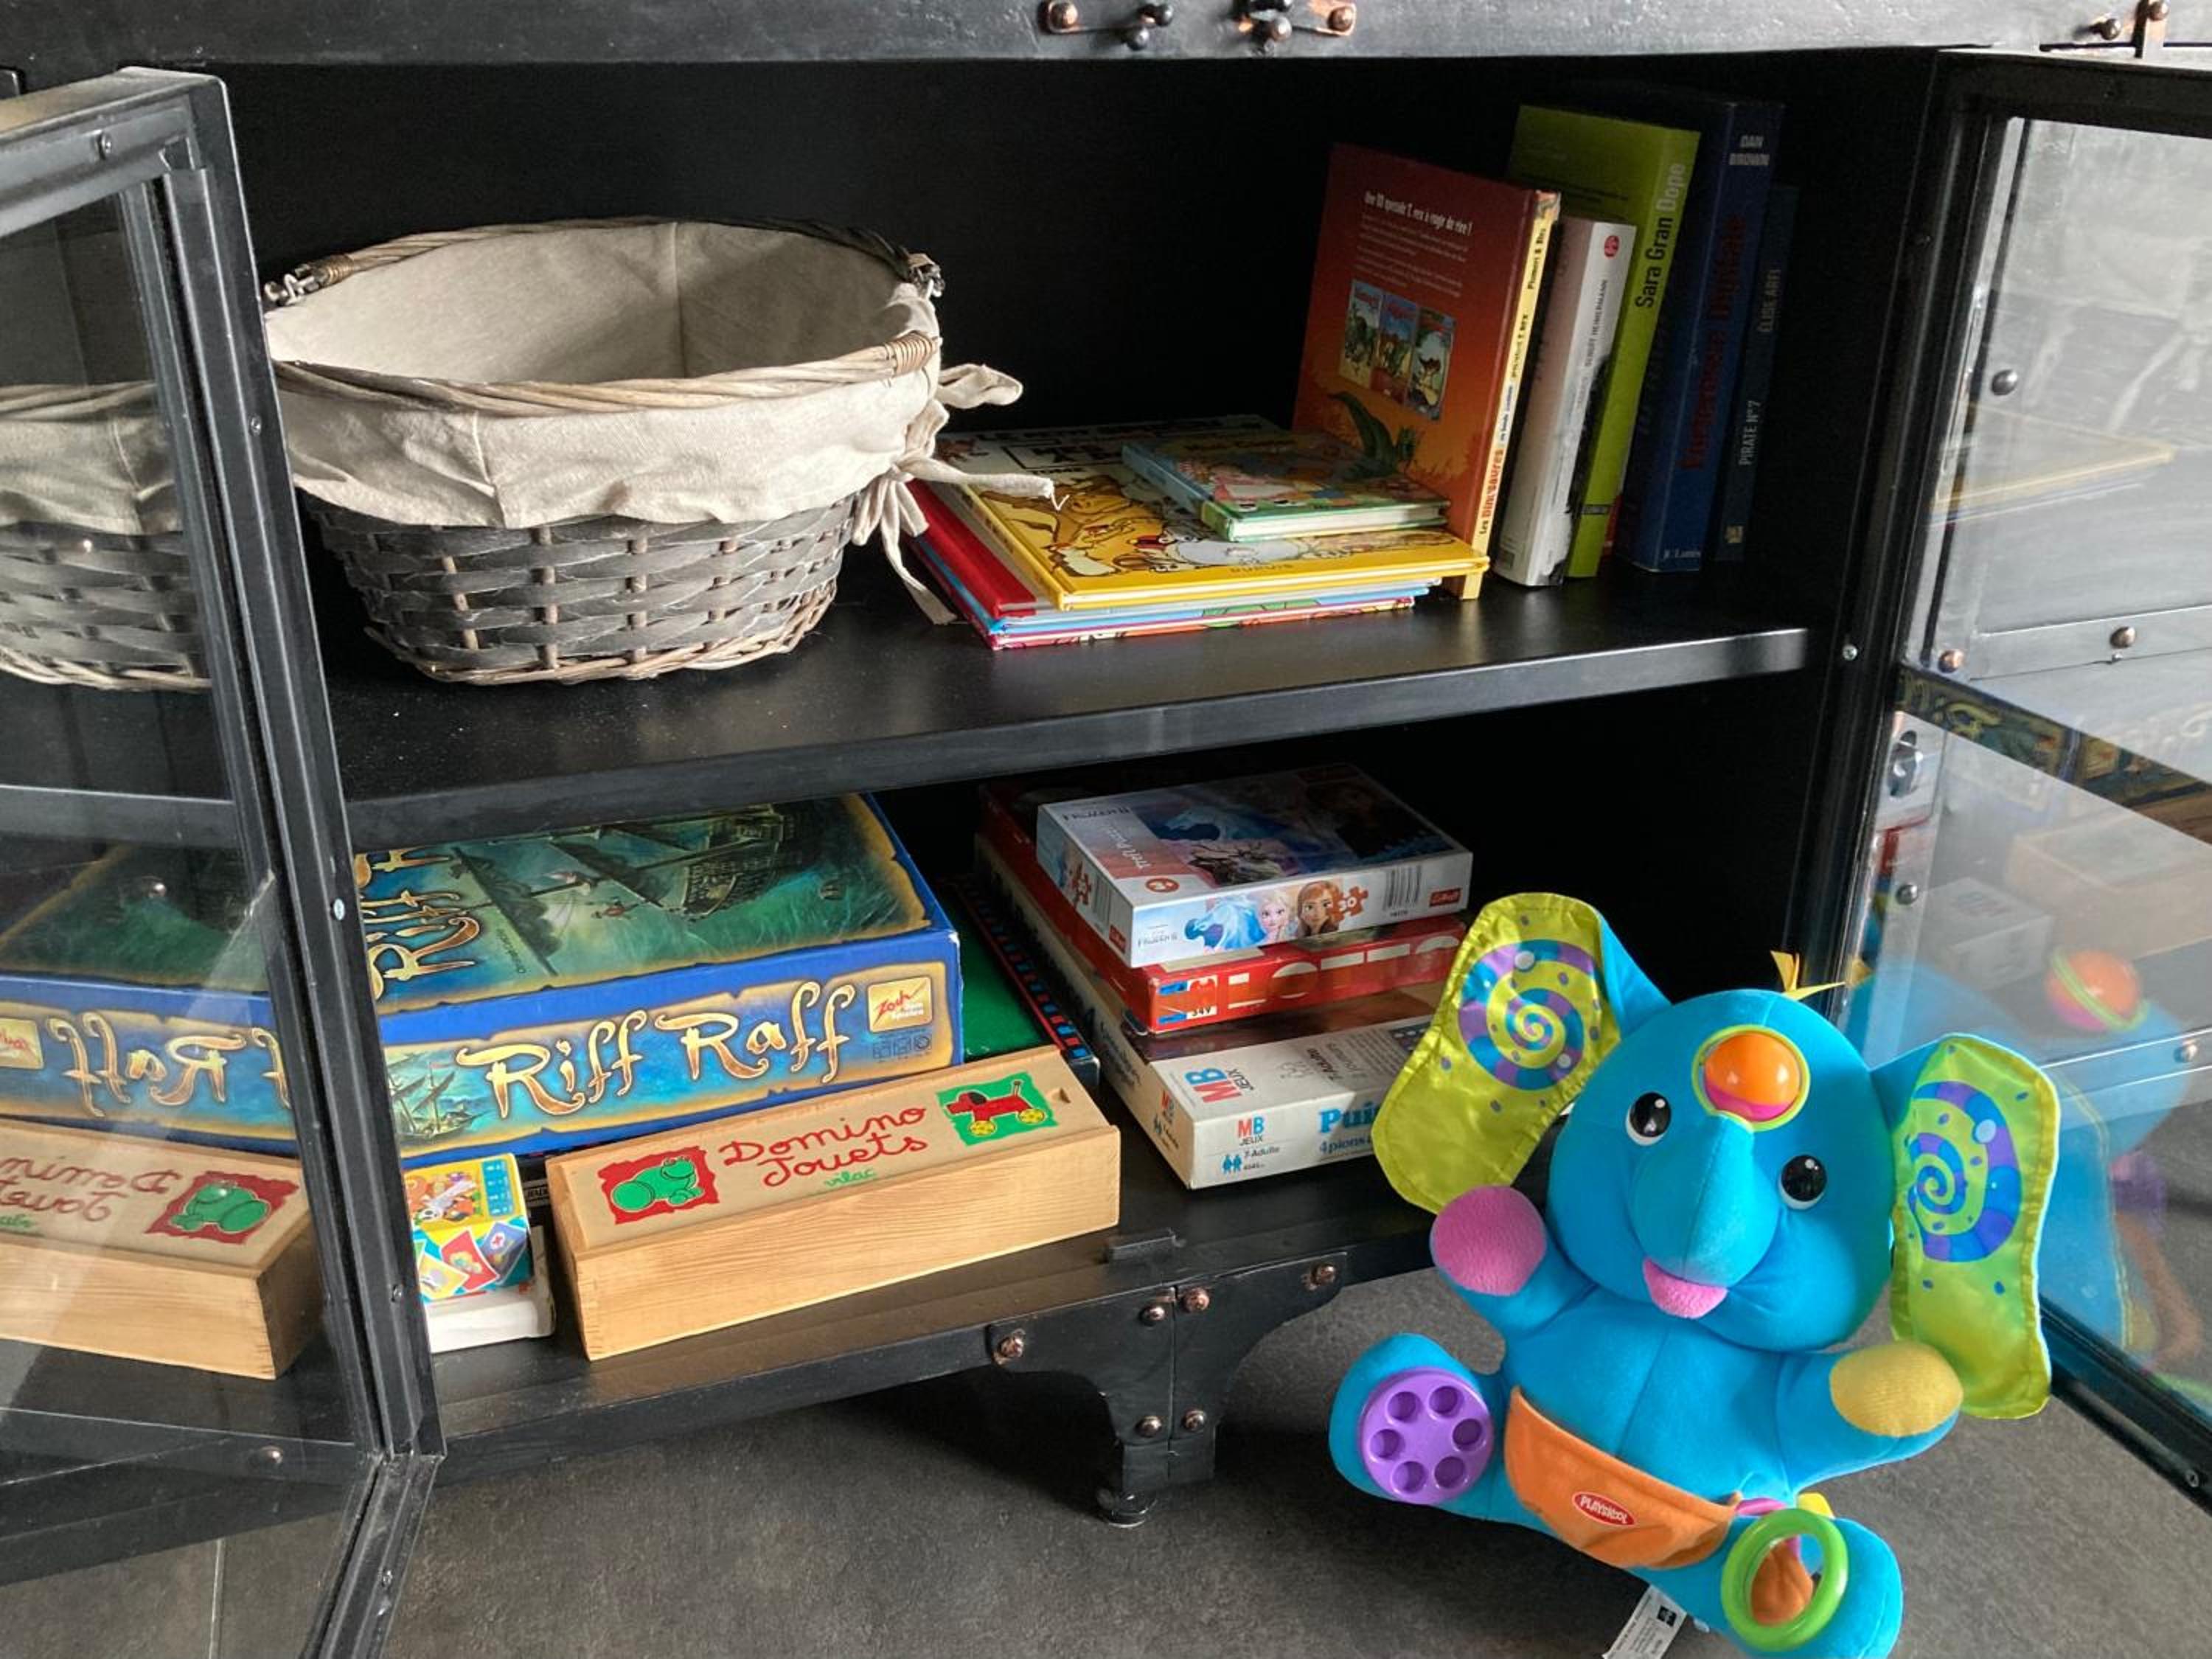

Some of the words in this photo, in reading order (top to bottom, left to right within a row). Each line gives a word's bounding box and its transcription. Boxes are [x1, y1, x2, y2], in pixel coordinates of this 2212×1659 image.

[1659, 164, 1684, 212] Dope
[1645, 217, 1672, 262] Gran
[1637, 260, 1661, 307] Sara
[1739, 425, 1759, 467] PIRATE
[456, 1008, 649, 1119] Riff
[654, 980, 856, 1085] Raff
[1185, 1067, 1242, 1104] MB
[720, 1105, 929, 1168] Domino
[1237, 1116, 1266, 1138] MB
[1239, 1135, 1264, 1147] JEUX
[762, 1135, 930, 1188] Jouets
[822, 1166, 880, 1188] vilac
[1580, 1495, 1627, 1524] PLAYSKOOL
